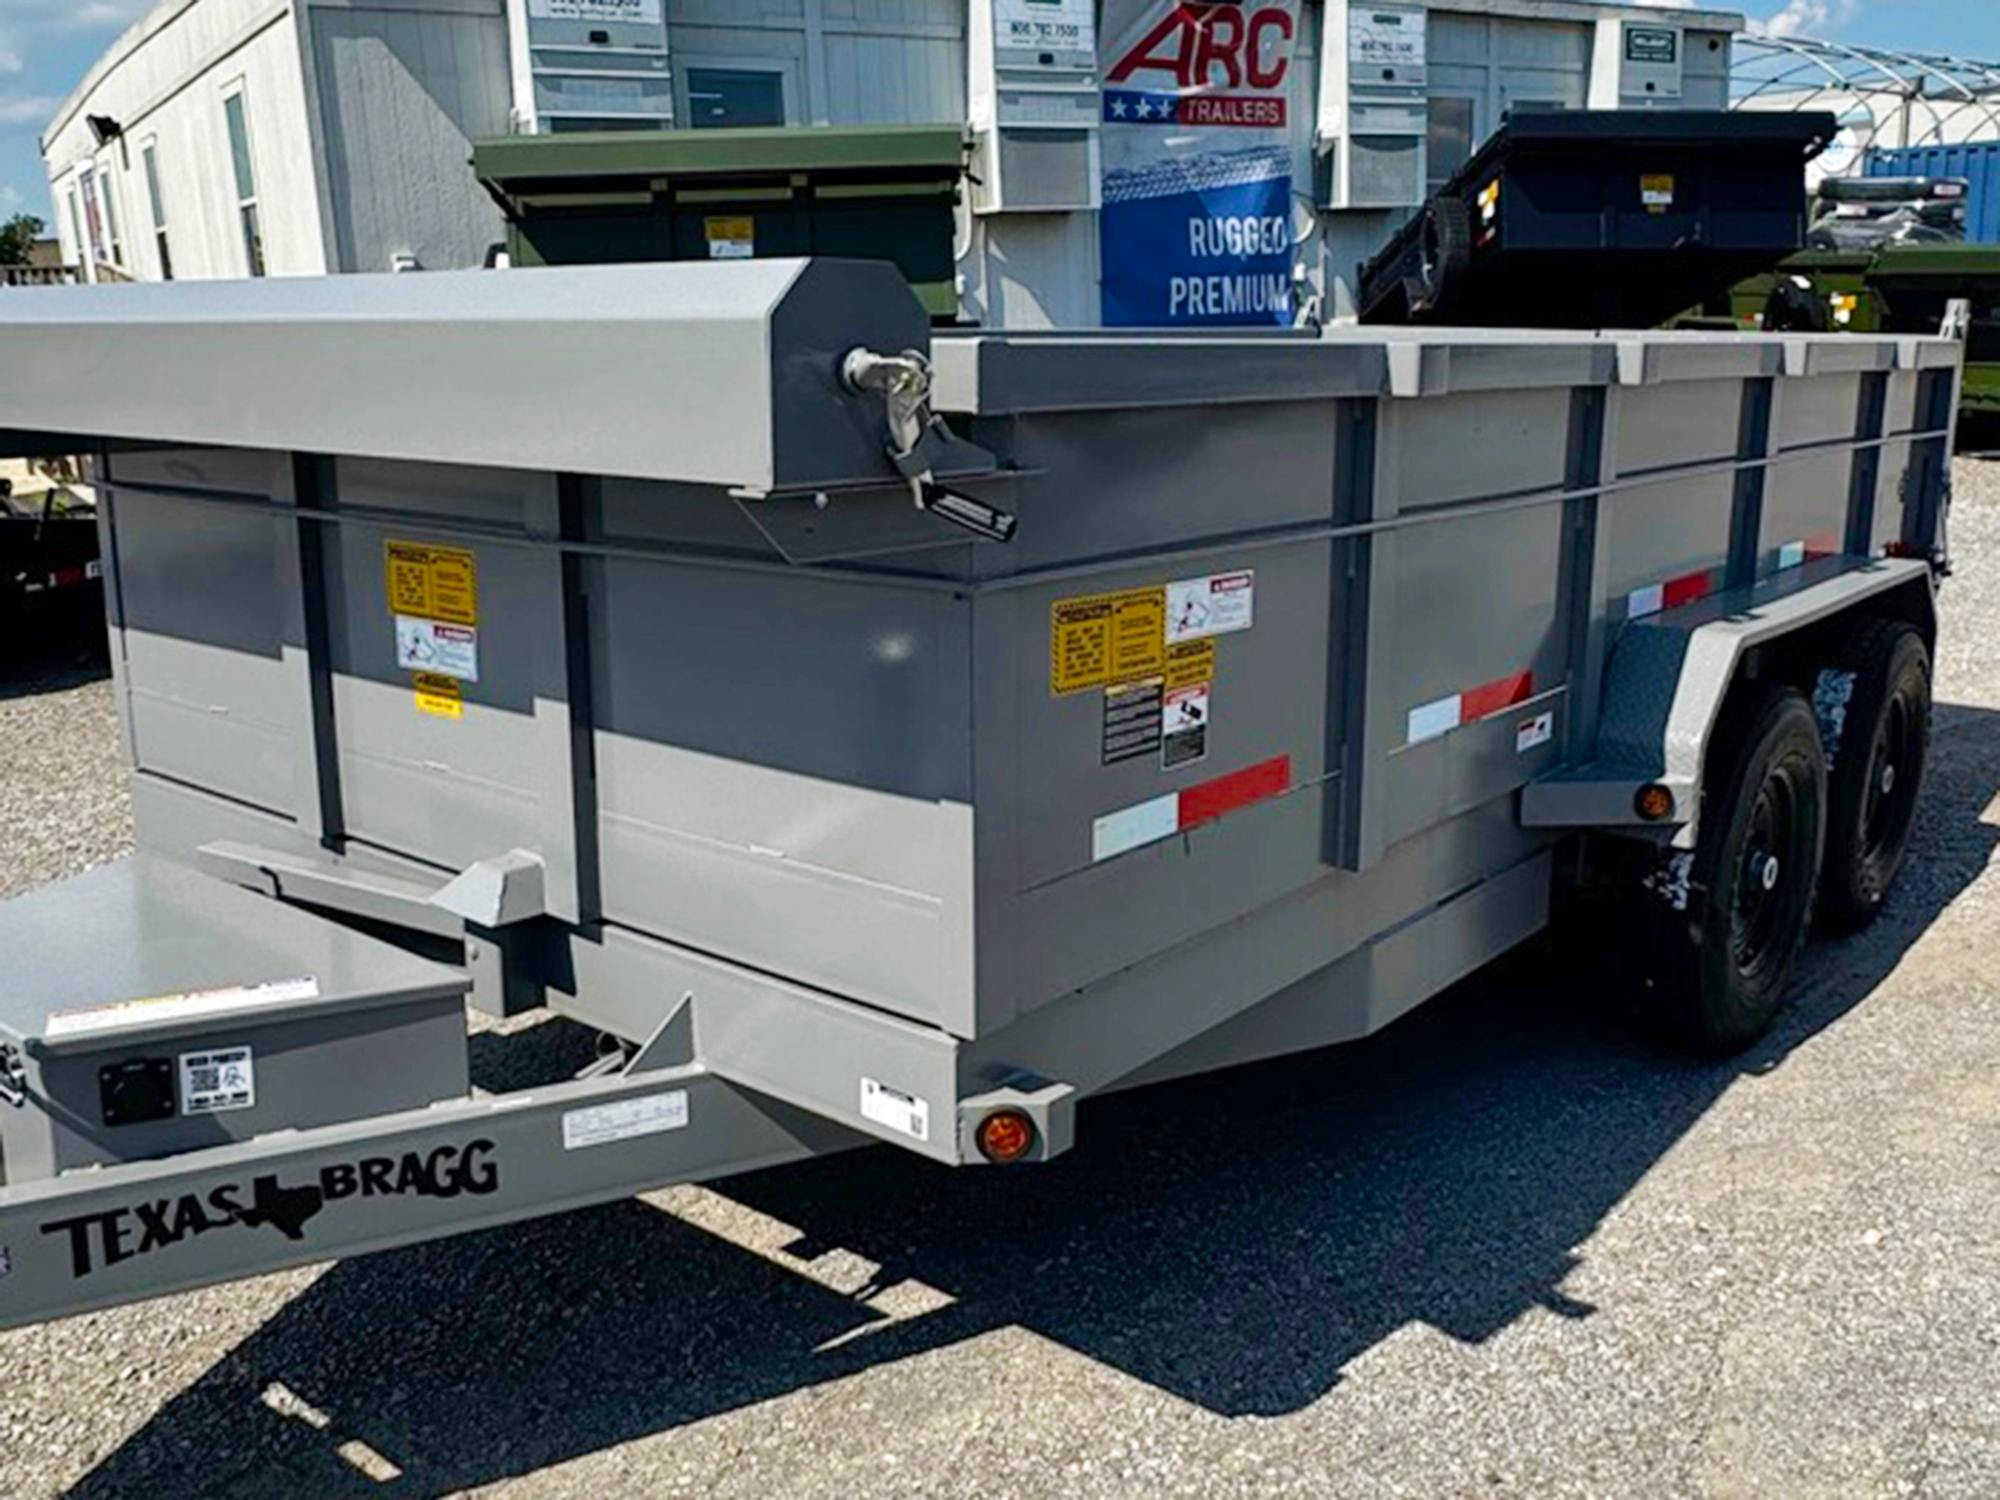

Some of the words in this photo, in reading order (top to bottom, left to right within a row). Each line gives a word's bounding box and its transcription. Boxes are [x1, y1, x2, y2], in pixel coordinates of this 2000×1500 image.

[1105, 3, 1292, 89] ARC
[1187, 100, 1281, 122] TRAILERS
[1189, 216, 1288, 257] RUGGED
[1169, 273, 1290, 316] PREMIUM
[40, 1184, 243, 1279] TEXAS
[320, 1138, 498, 1200] BRAGG
